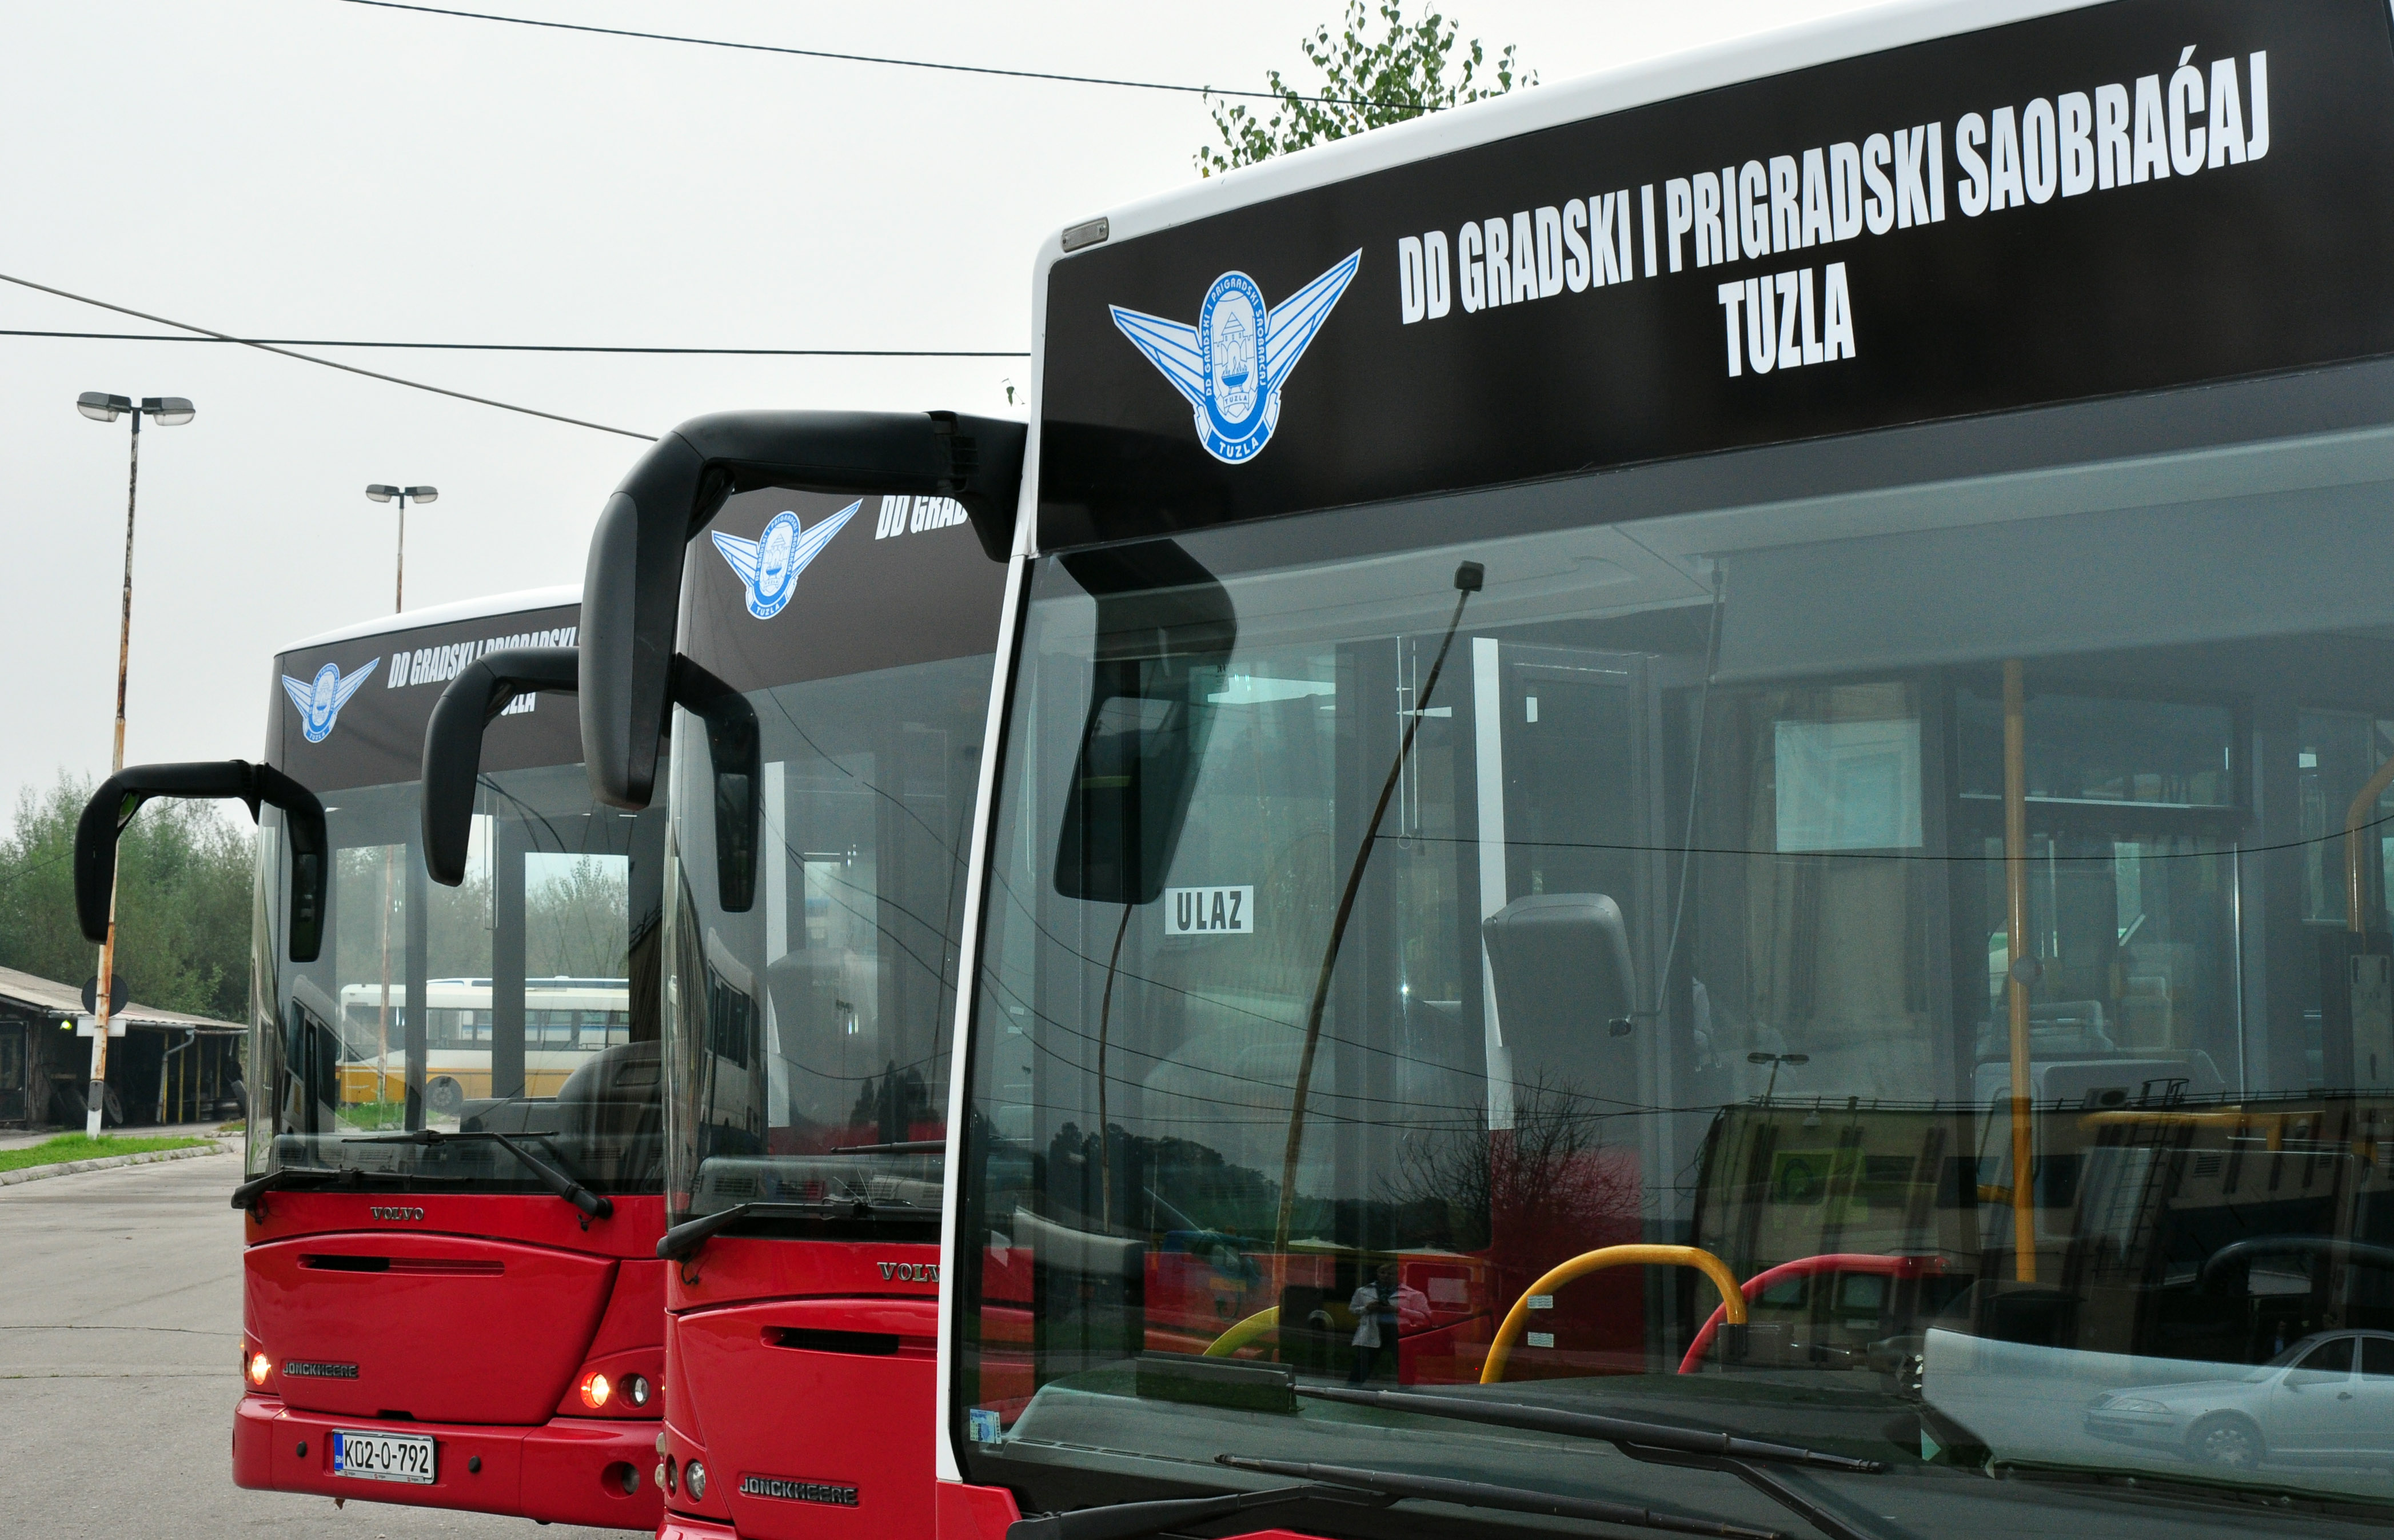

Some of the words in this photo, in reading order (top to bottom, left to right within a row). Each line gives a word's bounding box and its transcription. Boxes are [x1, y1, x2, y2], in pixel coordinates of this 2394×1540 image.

[1399, 231, 1450, 324] DD
[1459, 190, 1633, 313] GRADSKI
[1641, 184, 1657, 277] I
[1666, 122, 1945, 273] PRIGRADSKI
[1956, 45, 2269, 217] SAOBRAĆAJ
[1211, 277, 1259, 306] PRIGRADSKI
[1718, 262, 1856, 377] TUZLA
[1203, 314, 1212, 373] GRADSKI
[1205, 378, 1212, 396] DD
[1224, 394, 1247, 404] TUZLA
[1219, 437, 1259, 457] TUZLA
[756, 603, 780, 616] TUZLA
[388, 652, 410, 688] DD
[410, 641, 474, 685] GRADSKI
[1178, 891, 1242, 931] ULAZ
[370, 1207, 424, 1220] VOLVO
[877, 1262, 940, 1282] VOLV
[282, 1362, 358, 1378] JONCKHEERE
[739, 1477, 858, 1506] JONCKHEERE
